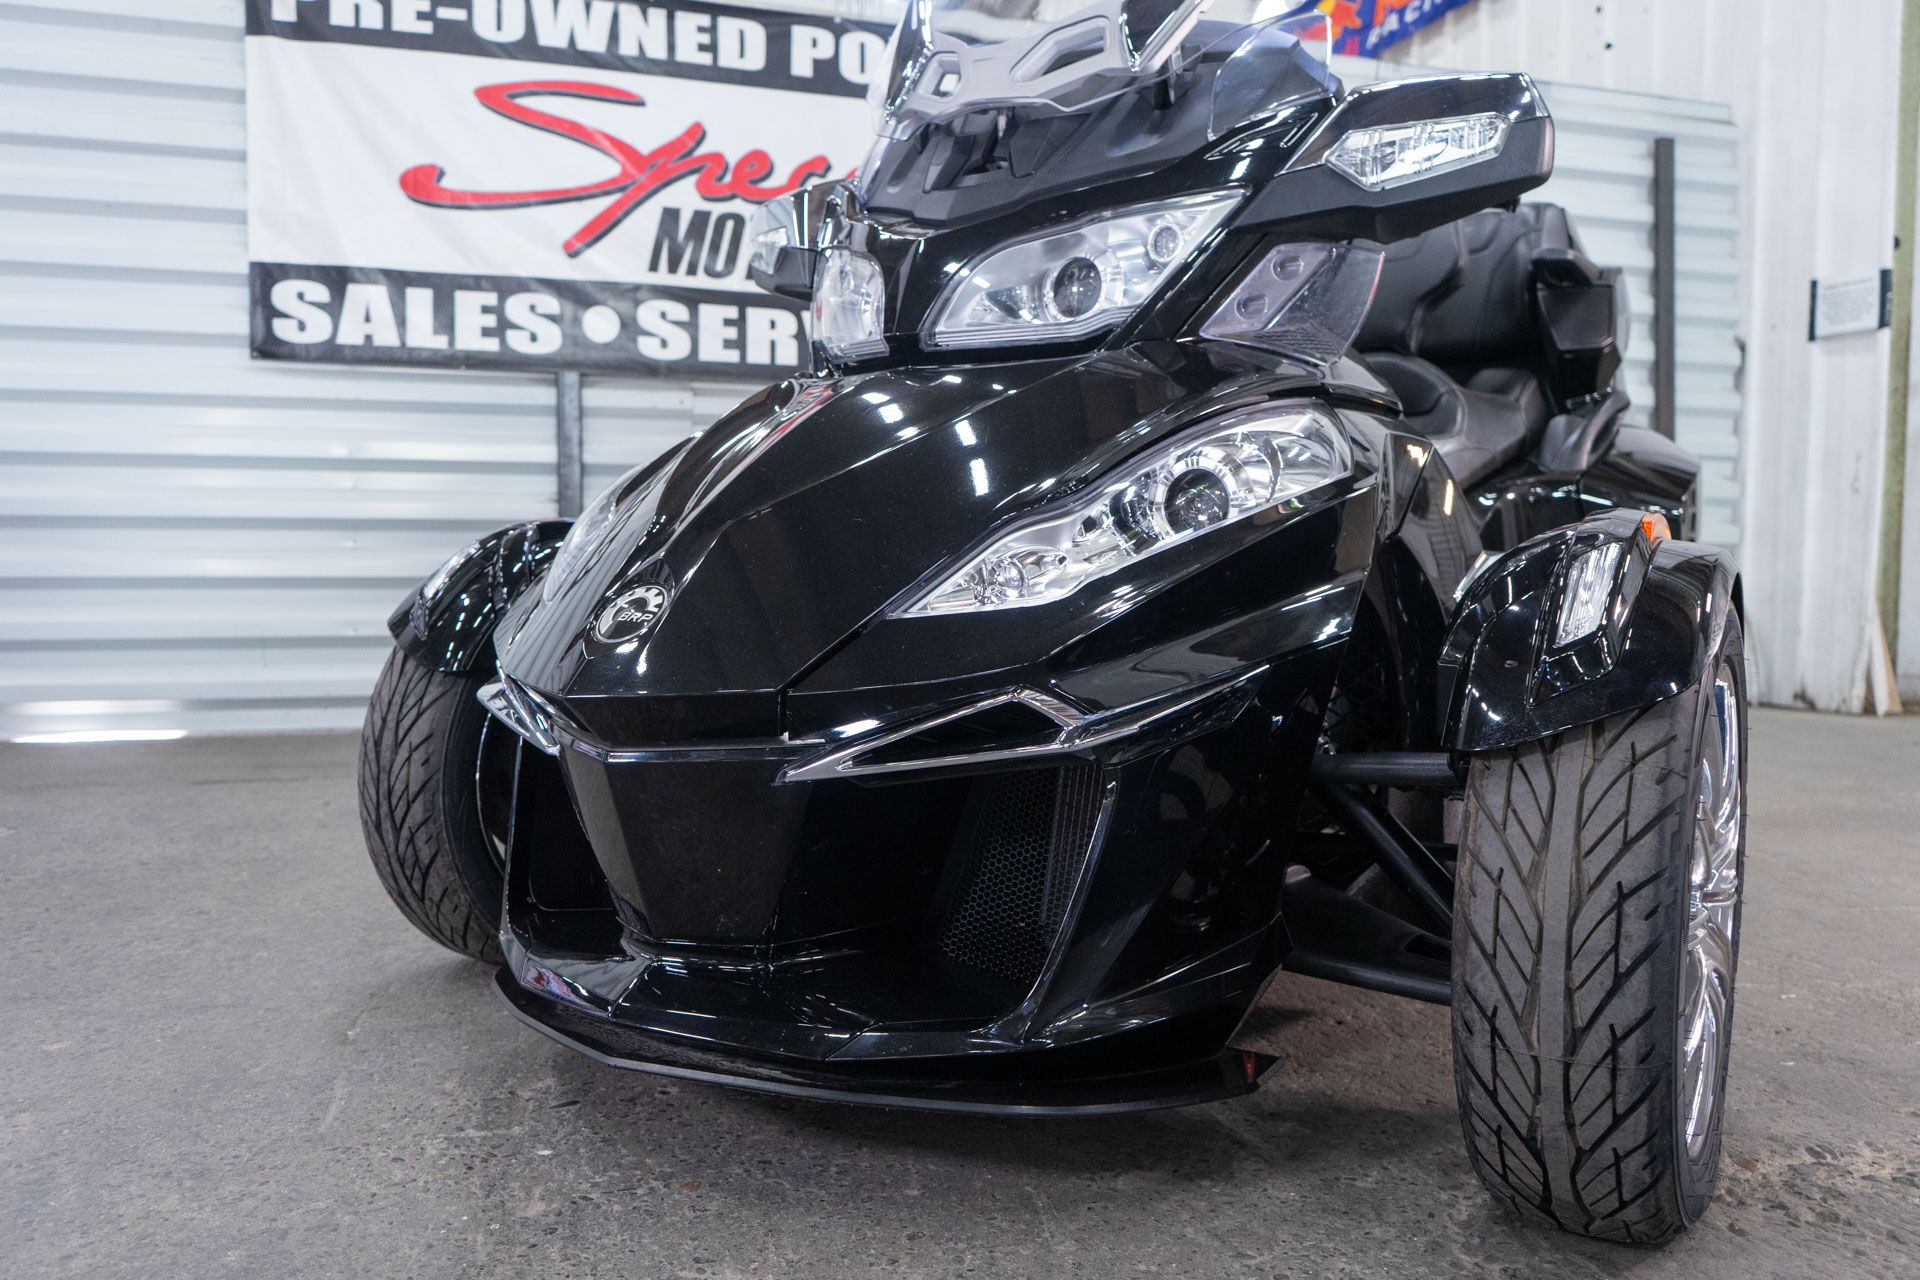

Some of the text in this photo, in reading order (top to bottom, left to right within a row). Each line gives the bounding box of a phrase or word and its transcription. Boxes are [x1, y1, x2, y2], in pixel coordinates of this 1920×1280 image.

[400, 80, 858, 257] Spec
[648, 207, 756, 280] MO
[270, 279, 812, 366] SALES SER
[618, 611, 654, 623] BRP
